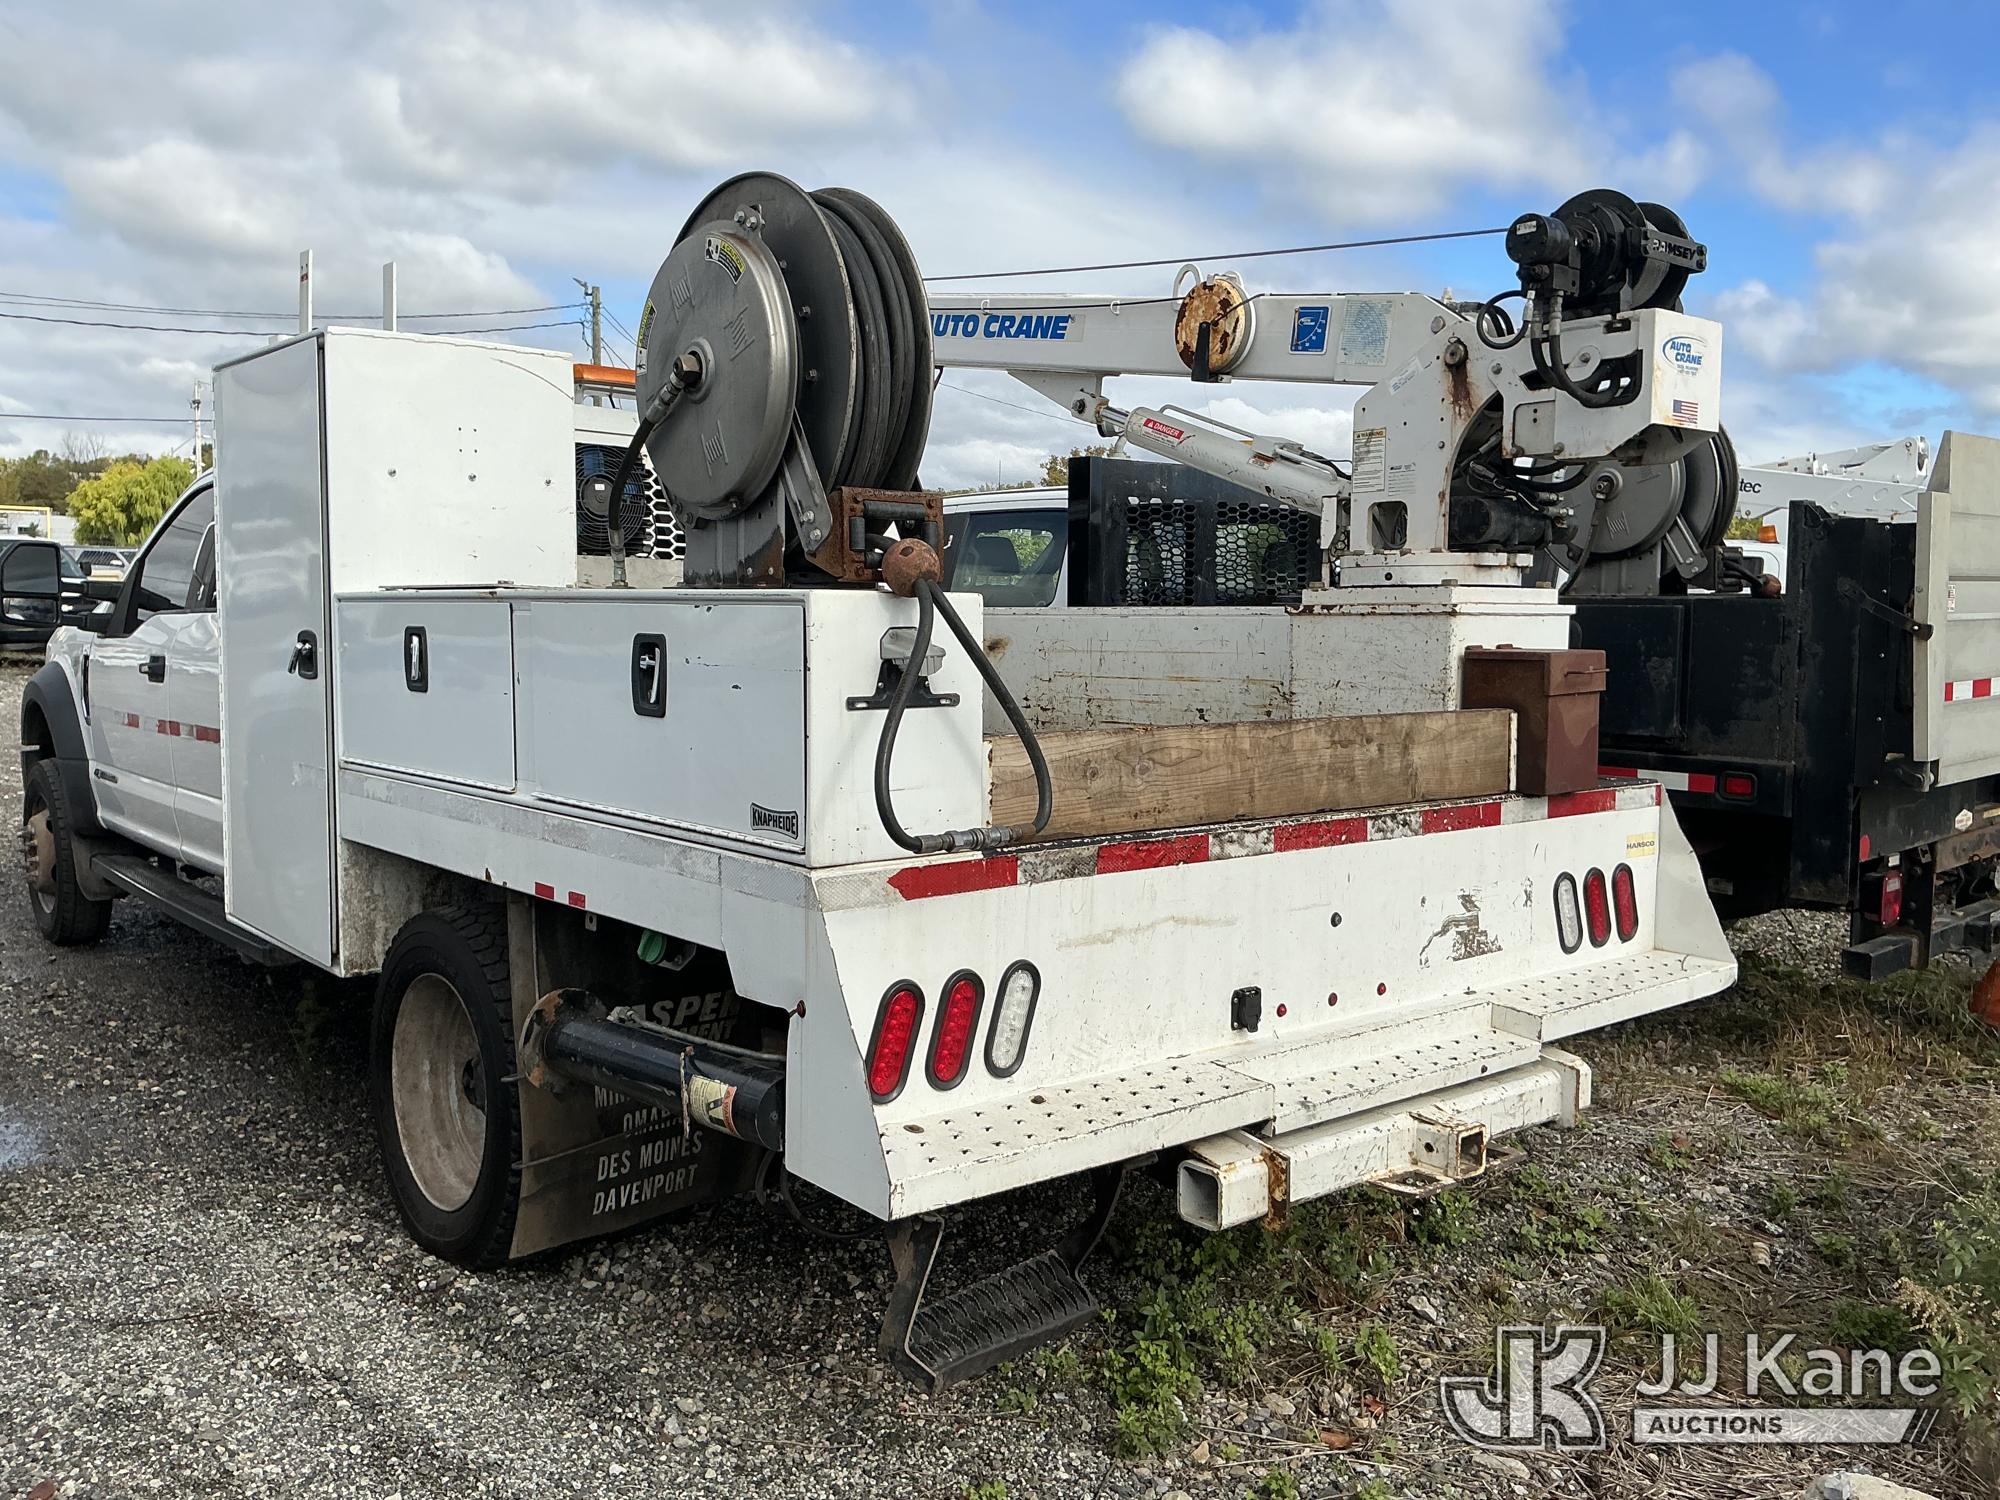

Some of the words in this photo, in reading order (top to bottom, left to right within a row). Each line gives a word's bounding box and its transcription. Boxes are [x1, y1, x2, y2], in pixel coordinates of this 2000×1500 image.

[1652, 239, 1696, 260] RAMSEY
[930, 313, 980, 337] UTO
[983, 314, 1069, 340] CRANE
[1670, 340, 1692, 352] AUTO
[1675, 352, 1702, 366] CRANE
[1153, 421, 1180, 437] DANGER
[1739, 478, 1762, 493] tec
[752, 807, 796, 835] KNAPHEIDE
[1626, 840, 1655, 849] HARSCO
[597, 1150, 631, 1182] DES
[639, 1131, 702, 1170] MOINES
[593, 1164, 698, 1216] DAVENPORT
